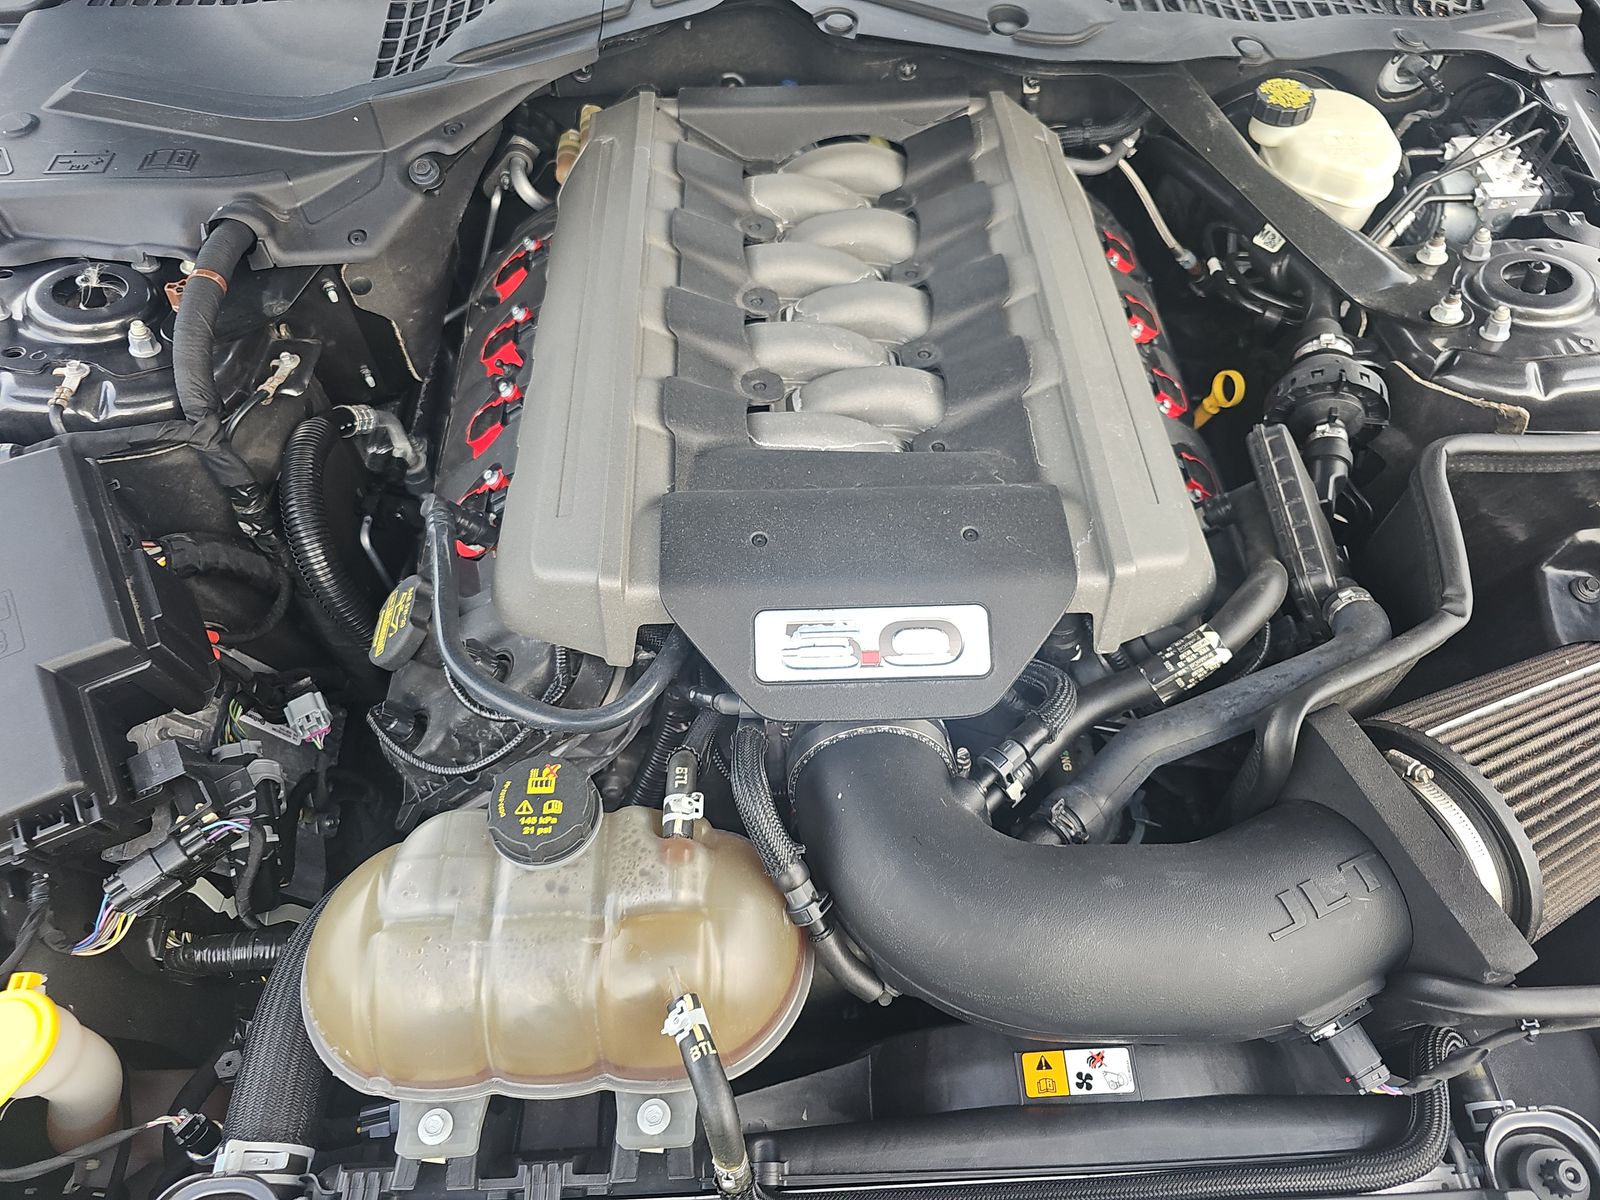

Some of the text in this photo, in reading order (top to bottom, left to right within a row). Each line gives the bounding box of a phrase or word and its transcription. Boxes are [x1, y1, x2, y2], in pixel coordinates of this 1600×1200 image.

[781, 618, 965, 670] 5.0
[522, 825, 552, 836] 21 psi
[538, 816, 558, 825] kPa
[1269, 851, 1382, 942] JLT
